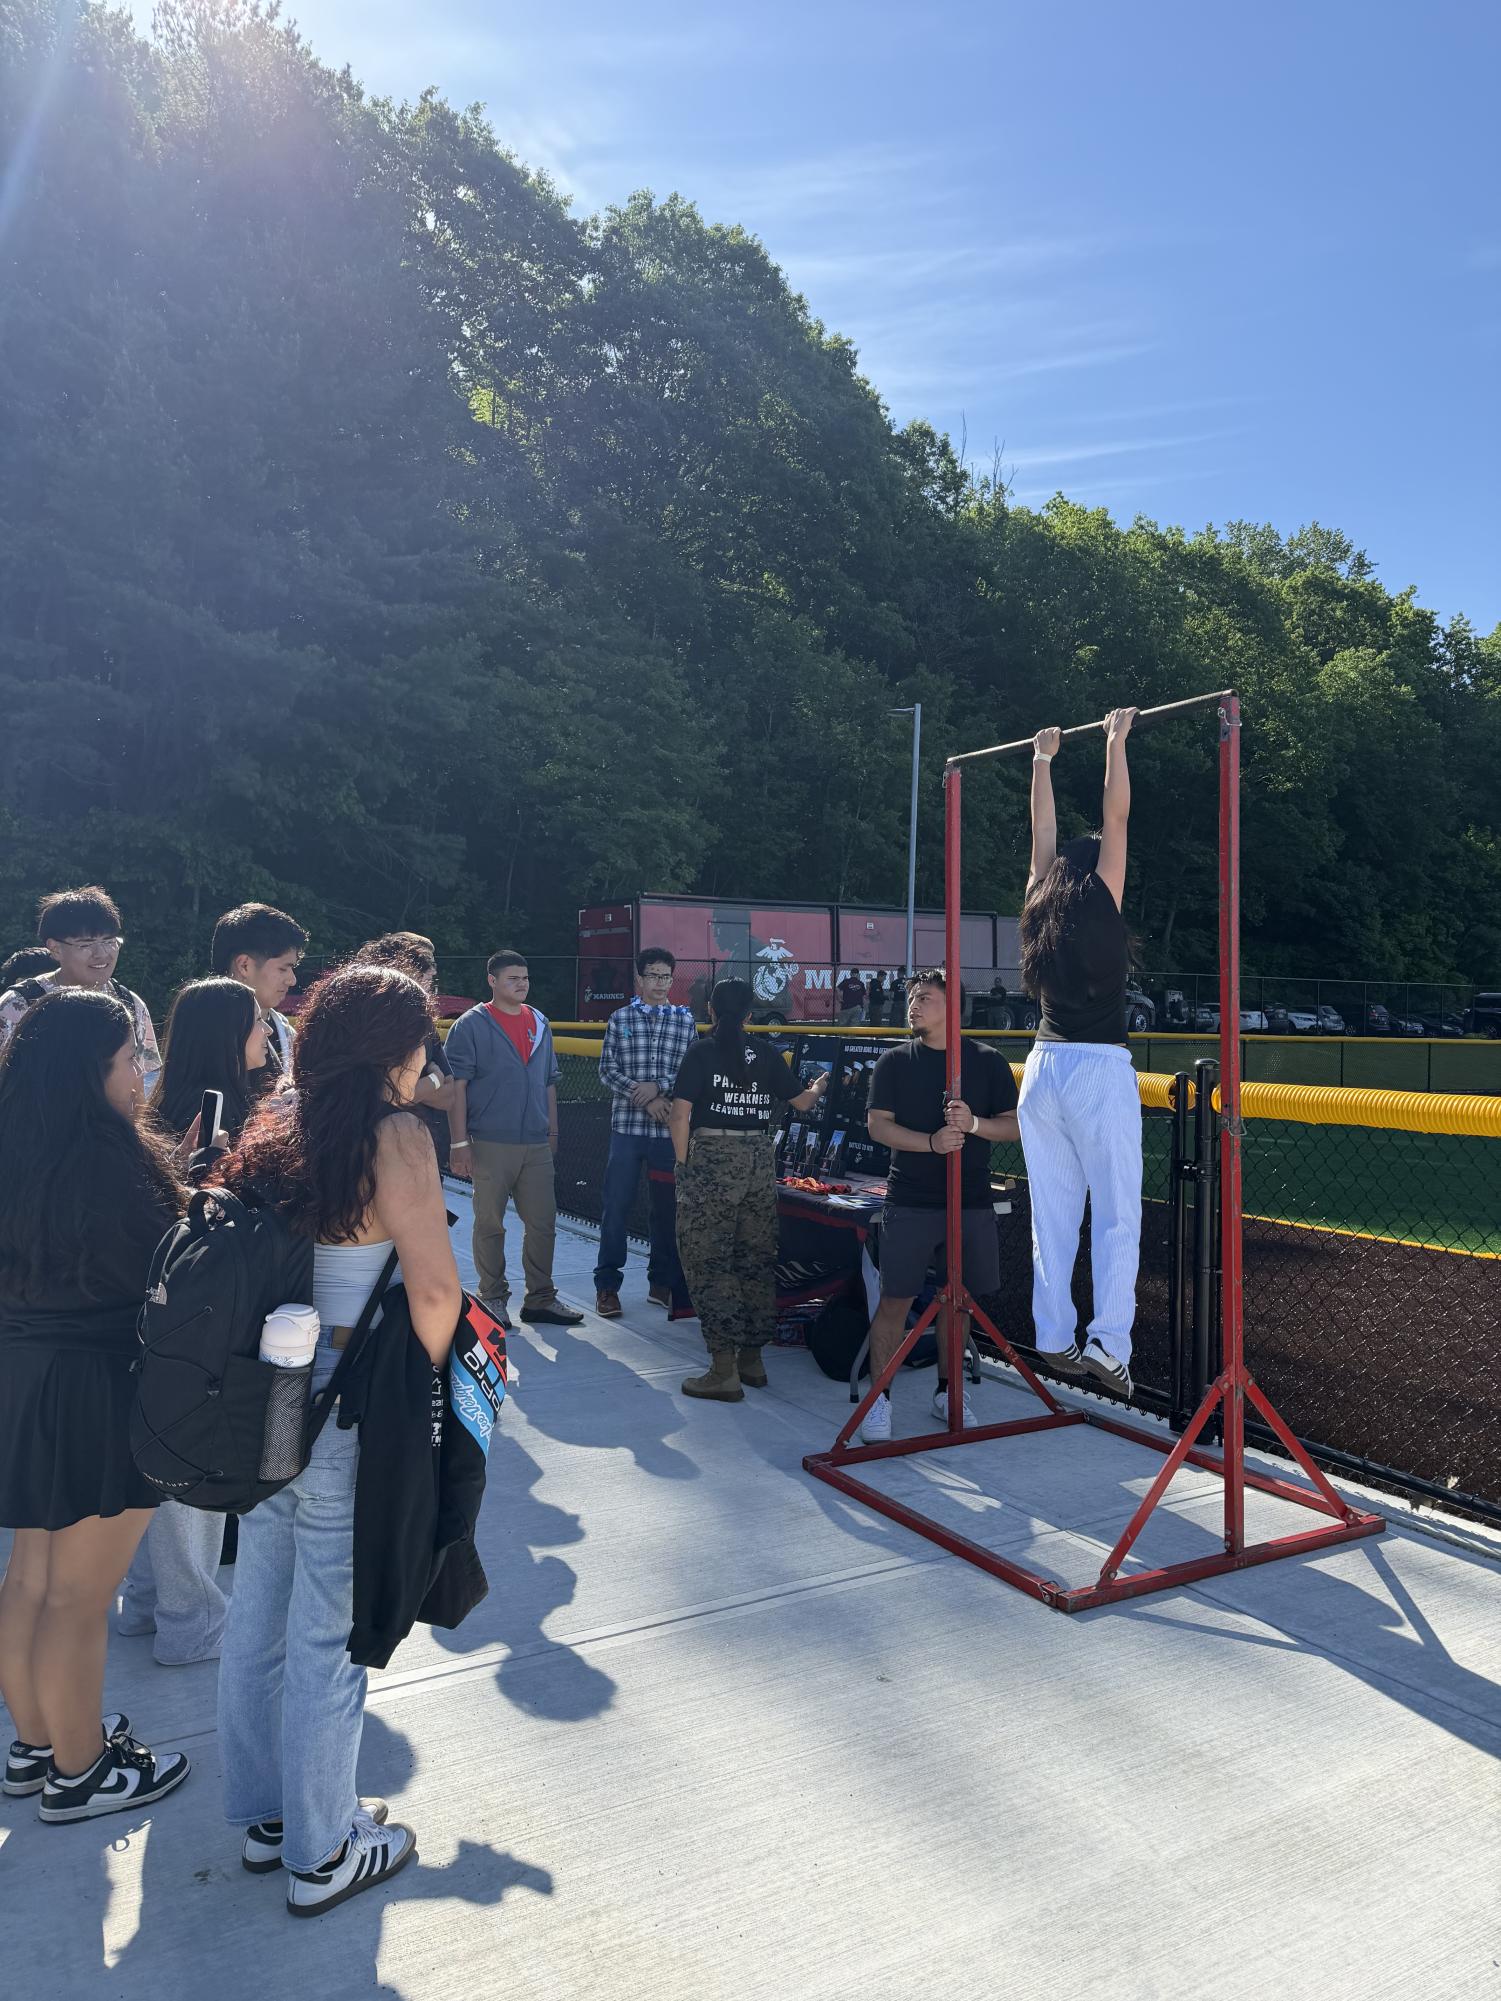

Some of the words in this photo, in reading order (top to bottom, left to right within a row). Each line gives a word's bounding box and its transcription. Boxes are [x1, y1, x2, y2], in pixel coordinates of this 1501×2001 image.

[710, 1102, 744, 1116] LEAVING
[746, 1107, 757, 1115] THE
[463, 1351, 500, 1412] oPro
